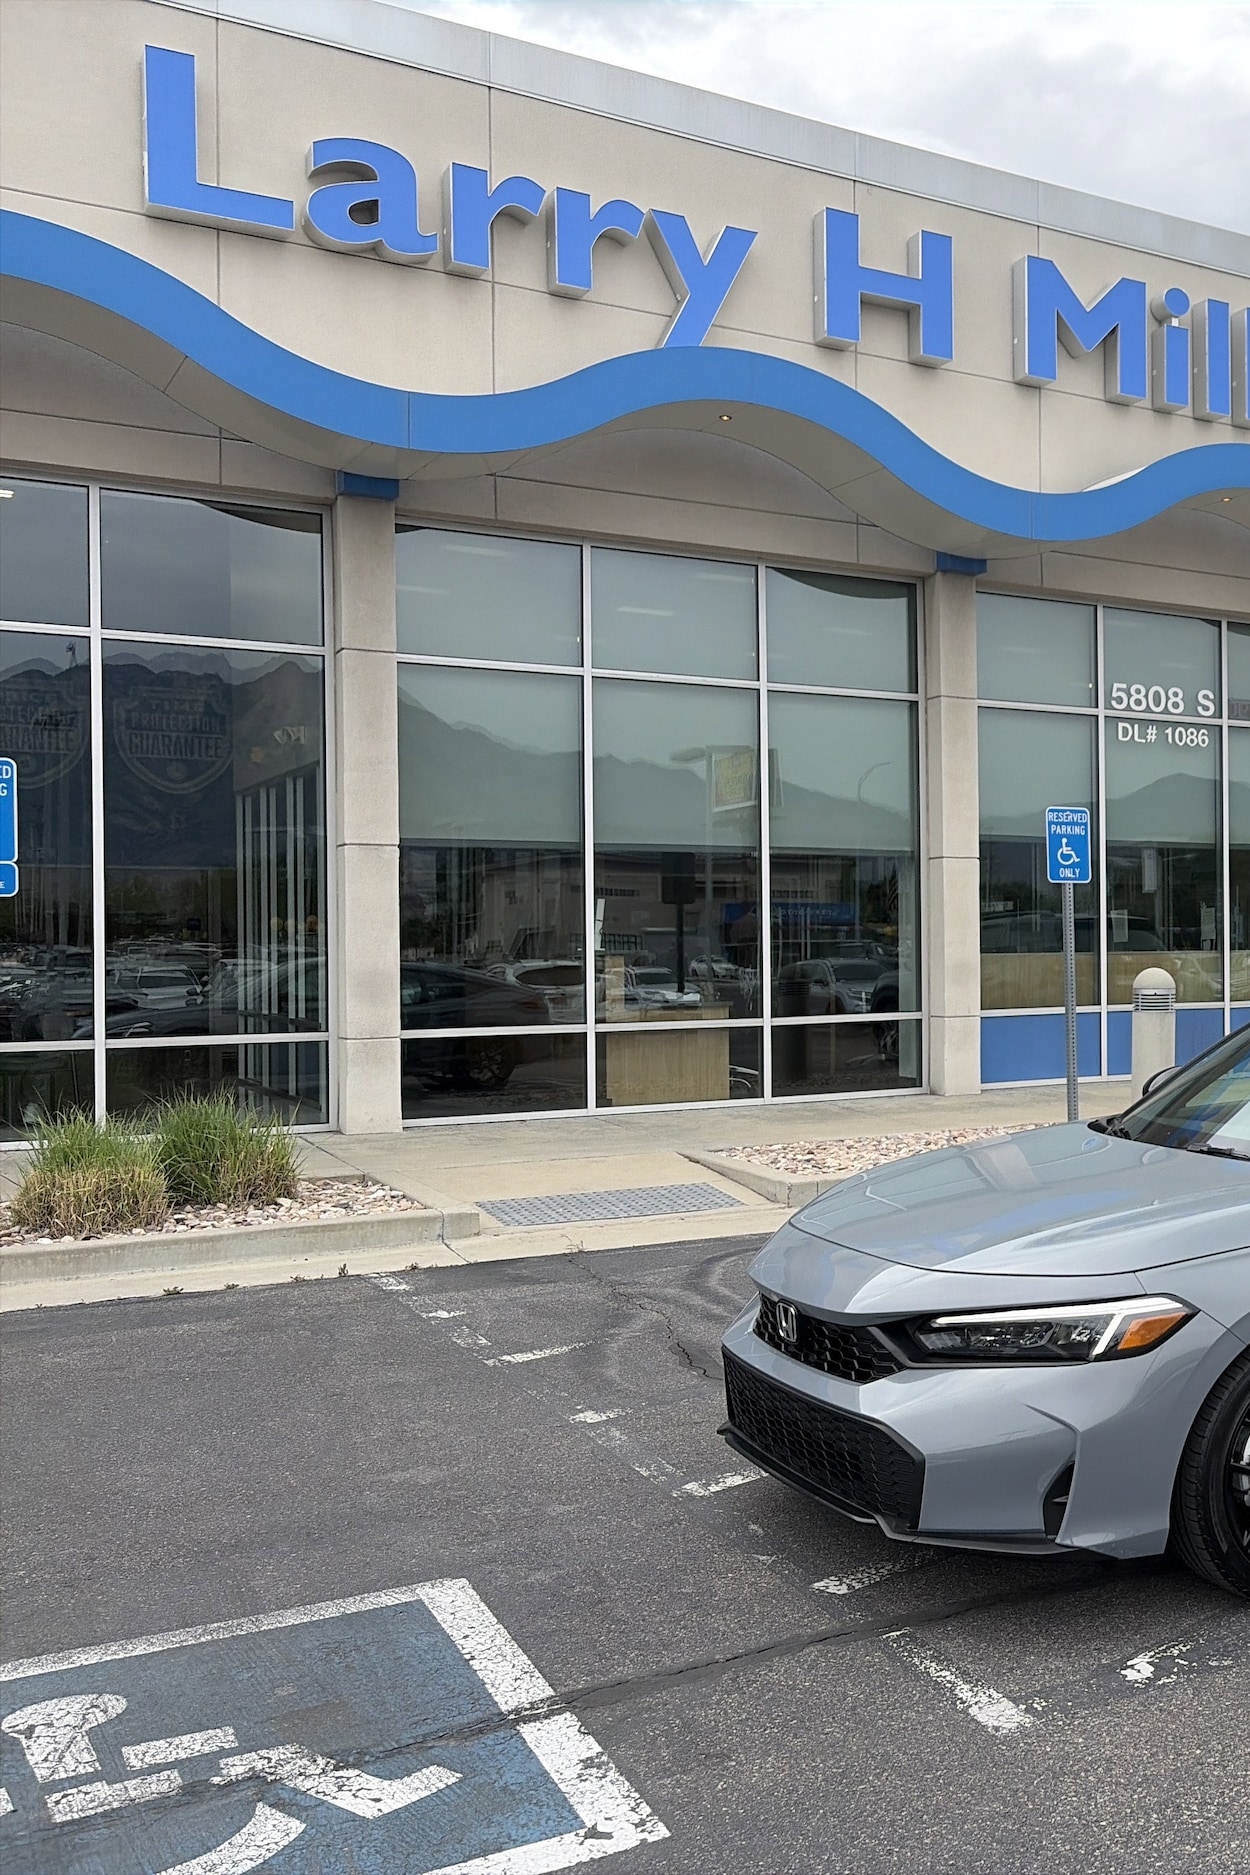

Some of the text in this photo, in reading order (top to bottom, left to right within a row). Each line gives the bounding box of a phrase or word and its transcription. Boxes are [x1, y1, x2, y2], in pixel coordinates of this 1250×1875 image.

[142, 44, 758, 348] Larry
[815, 206, 954, 368] H
[1110, 682, 1216, 717] 5808 S
[131, 711, 220, 732] PROTECTION
[129, 733, 224, 758] GUARANTEE
[1118, 721, 1209, 748] DL# 1086
[1048, 811, 1088, 823] RESERVED
[1051, 824, 1086, 836] PARKING
[1059, 867, 1080, 878] ONLY
